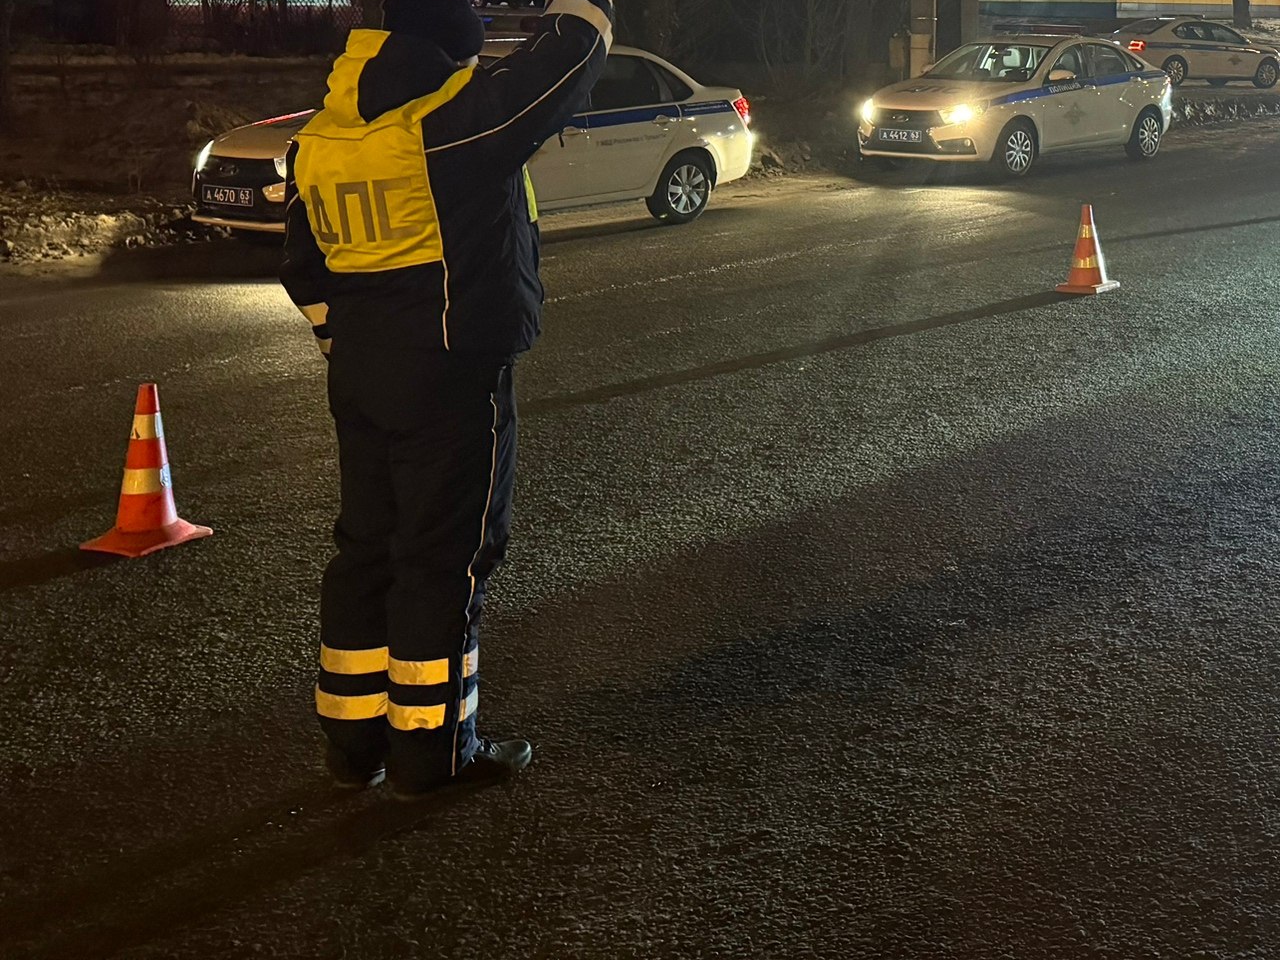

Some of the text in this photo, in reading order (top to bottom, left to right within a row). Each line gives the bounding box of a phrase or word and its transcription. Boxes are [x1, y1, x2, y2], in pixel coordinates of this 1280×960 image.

[1048, 82, 1082, 94] ПОЛИЦИЯ
[882, 130, 920, 141] А 4412 63
[206, 187, 250, 203] А 4670 63
[309, 177, 423, 245] ДПС
